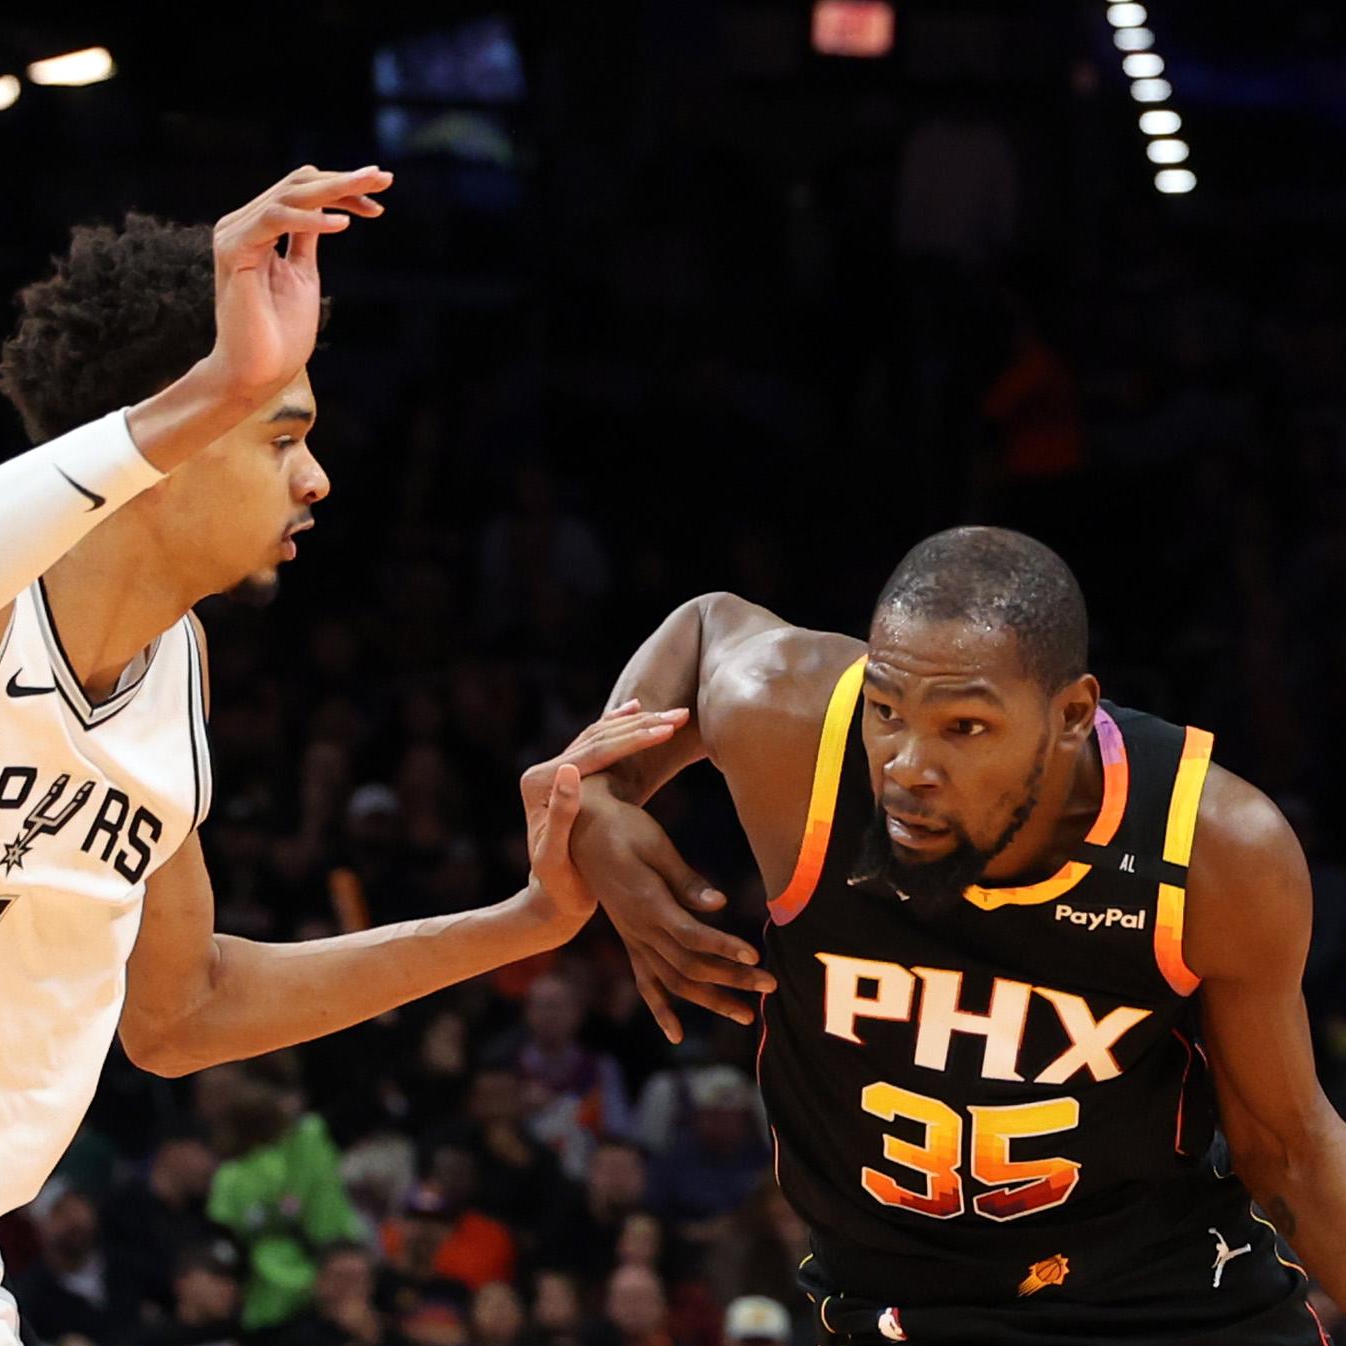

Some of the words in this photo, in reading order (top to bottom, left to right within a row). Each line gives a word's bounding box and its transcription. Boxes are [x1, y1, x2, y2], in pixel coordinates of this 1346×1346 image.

[1119, 854, 1136, 873] AL
[1055, 904, 1146, 930] PayPal
[814, 952, 1153, 1085] PHX
[861, 1081, 1082, 1222] 35
